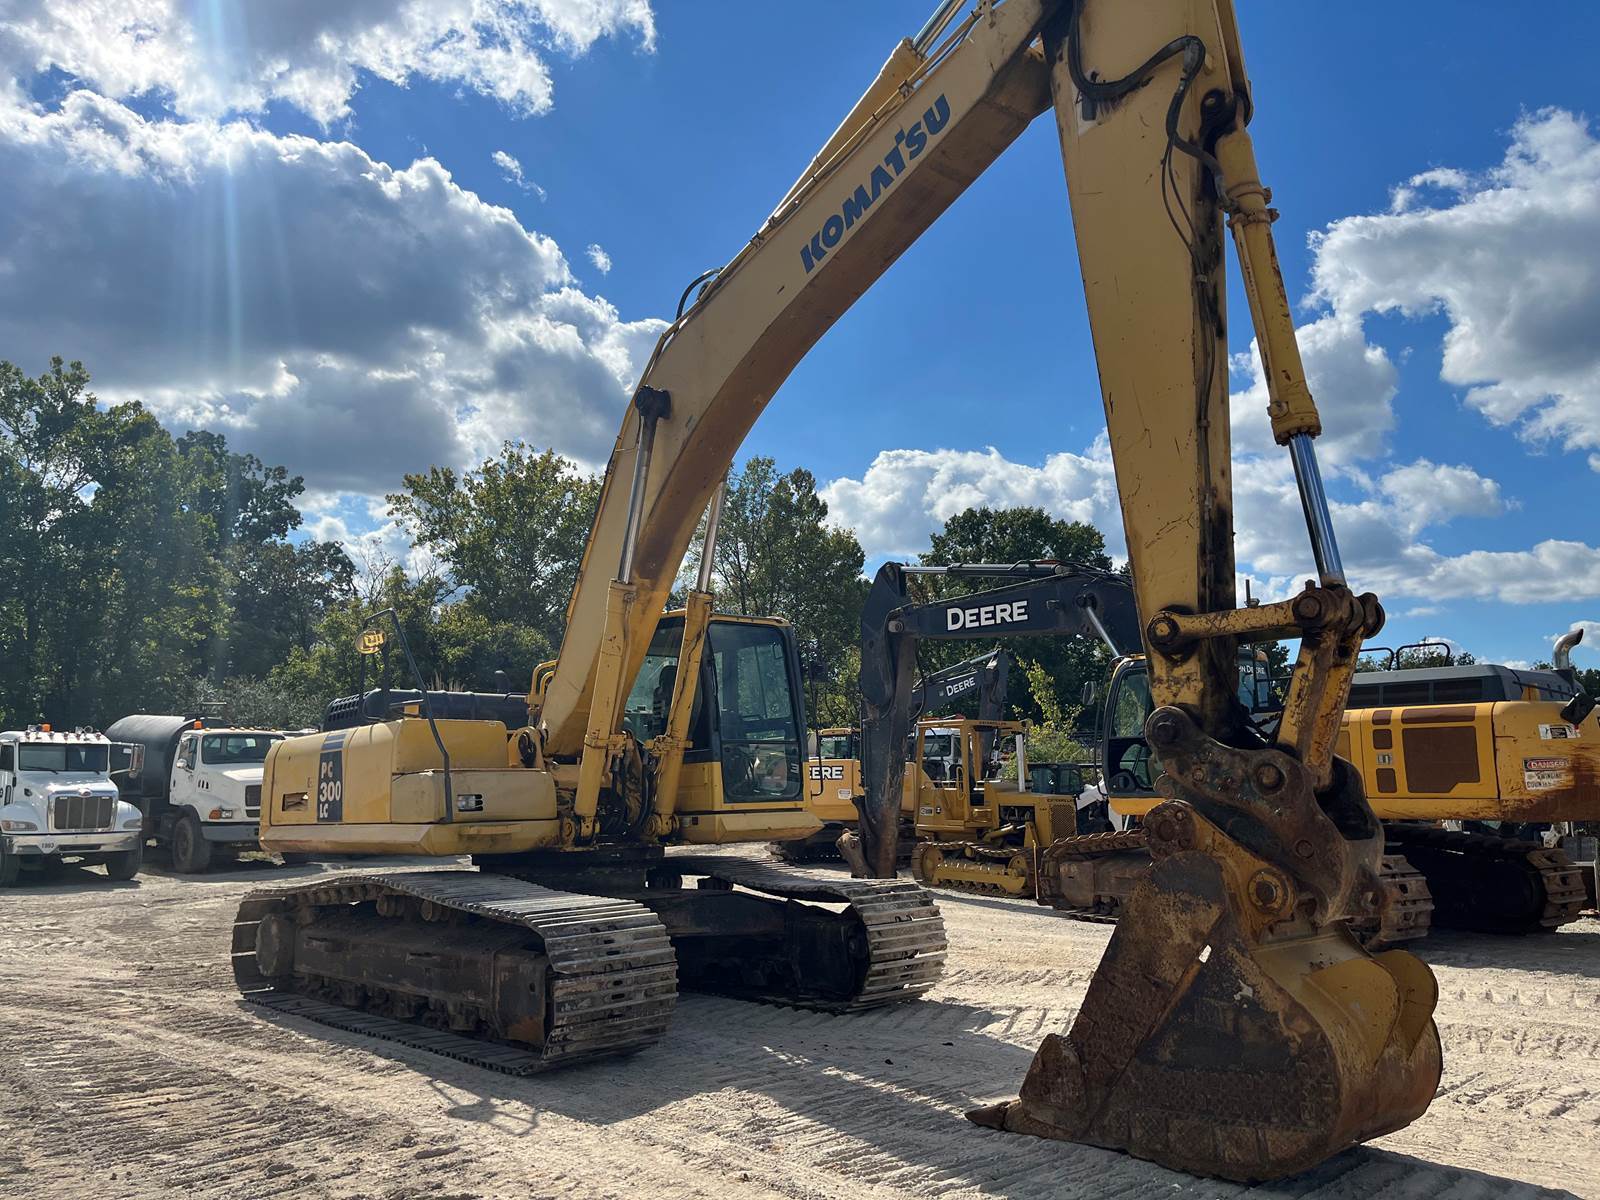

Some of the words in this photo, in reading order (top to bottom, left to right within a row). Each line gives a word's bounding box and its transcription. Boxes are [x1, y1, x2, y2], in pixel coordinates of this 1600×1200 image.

[800, 93, 951, 274] KOMATSU
[946, 600, 1029, 631] DEERE
[945, 677, 976, 697] DEERE
[321, 760, 334, 779] PC
[809, 766, 844, 779] ERE
[319, 780, 342, 802] 300
[319, 803, 329, 819] LC
